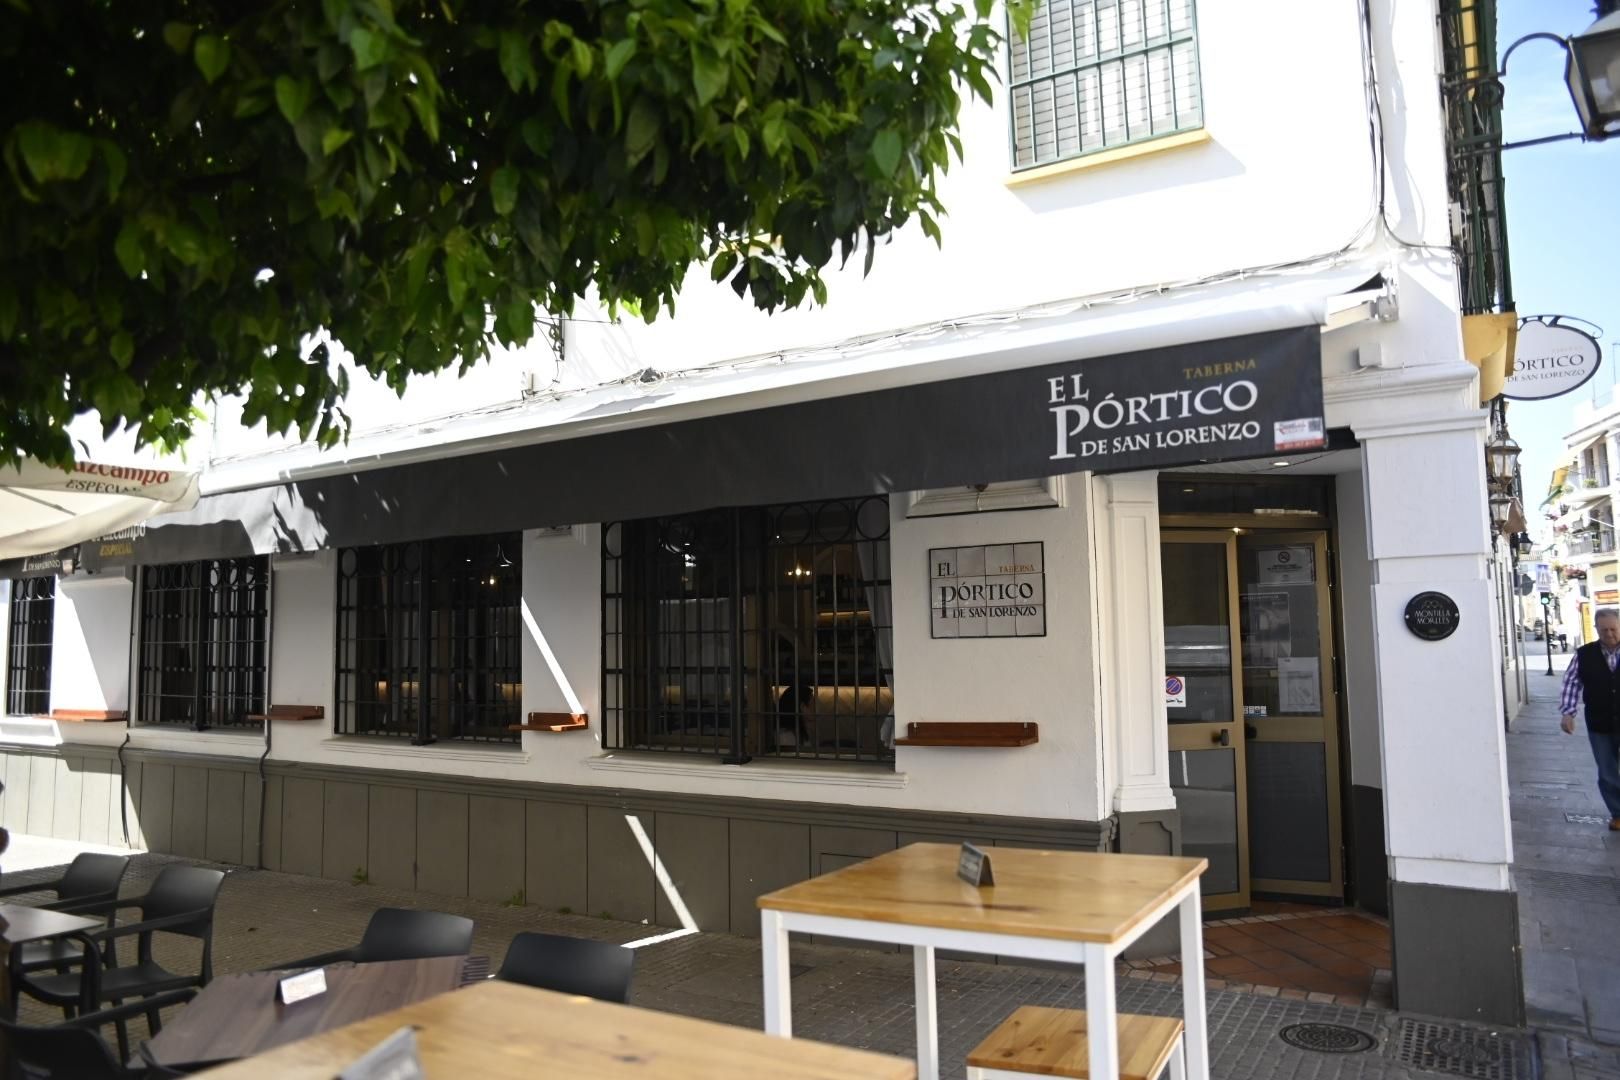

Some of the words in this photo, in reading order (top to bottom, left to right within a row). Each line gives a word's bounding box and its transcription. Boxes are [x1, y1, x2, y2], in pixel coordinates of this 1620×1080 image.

[1183, 358, 1257, 380] TABERNA
[1512, 354, 1584, 372] ÓRTICO
[1521, 371, 1538, 381] SAN
[1540, 368, 1585, 379] LORENZO
[1047, 372, 1090, 404] EL
[1048, 380, 1259, 460] PÓRTICO
[1081, 440, 1108, 457] DE
[1112, 433, 1151, 454] SAN
[1155, 421, 1261, 449] LORENZO
[937, 562, 955, 577] EL
[999, 564, 1035, 573] TABERNA
[938, 582, 1033, 618] PÓRTICO
[952, 608, 966, 618] DE
[968, 607, 987, 618] SAN
[989, 606, 1037, 617] LORENZO
